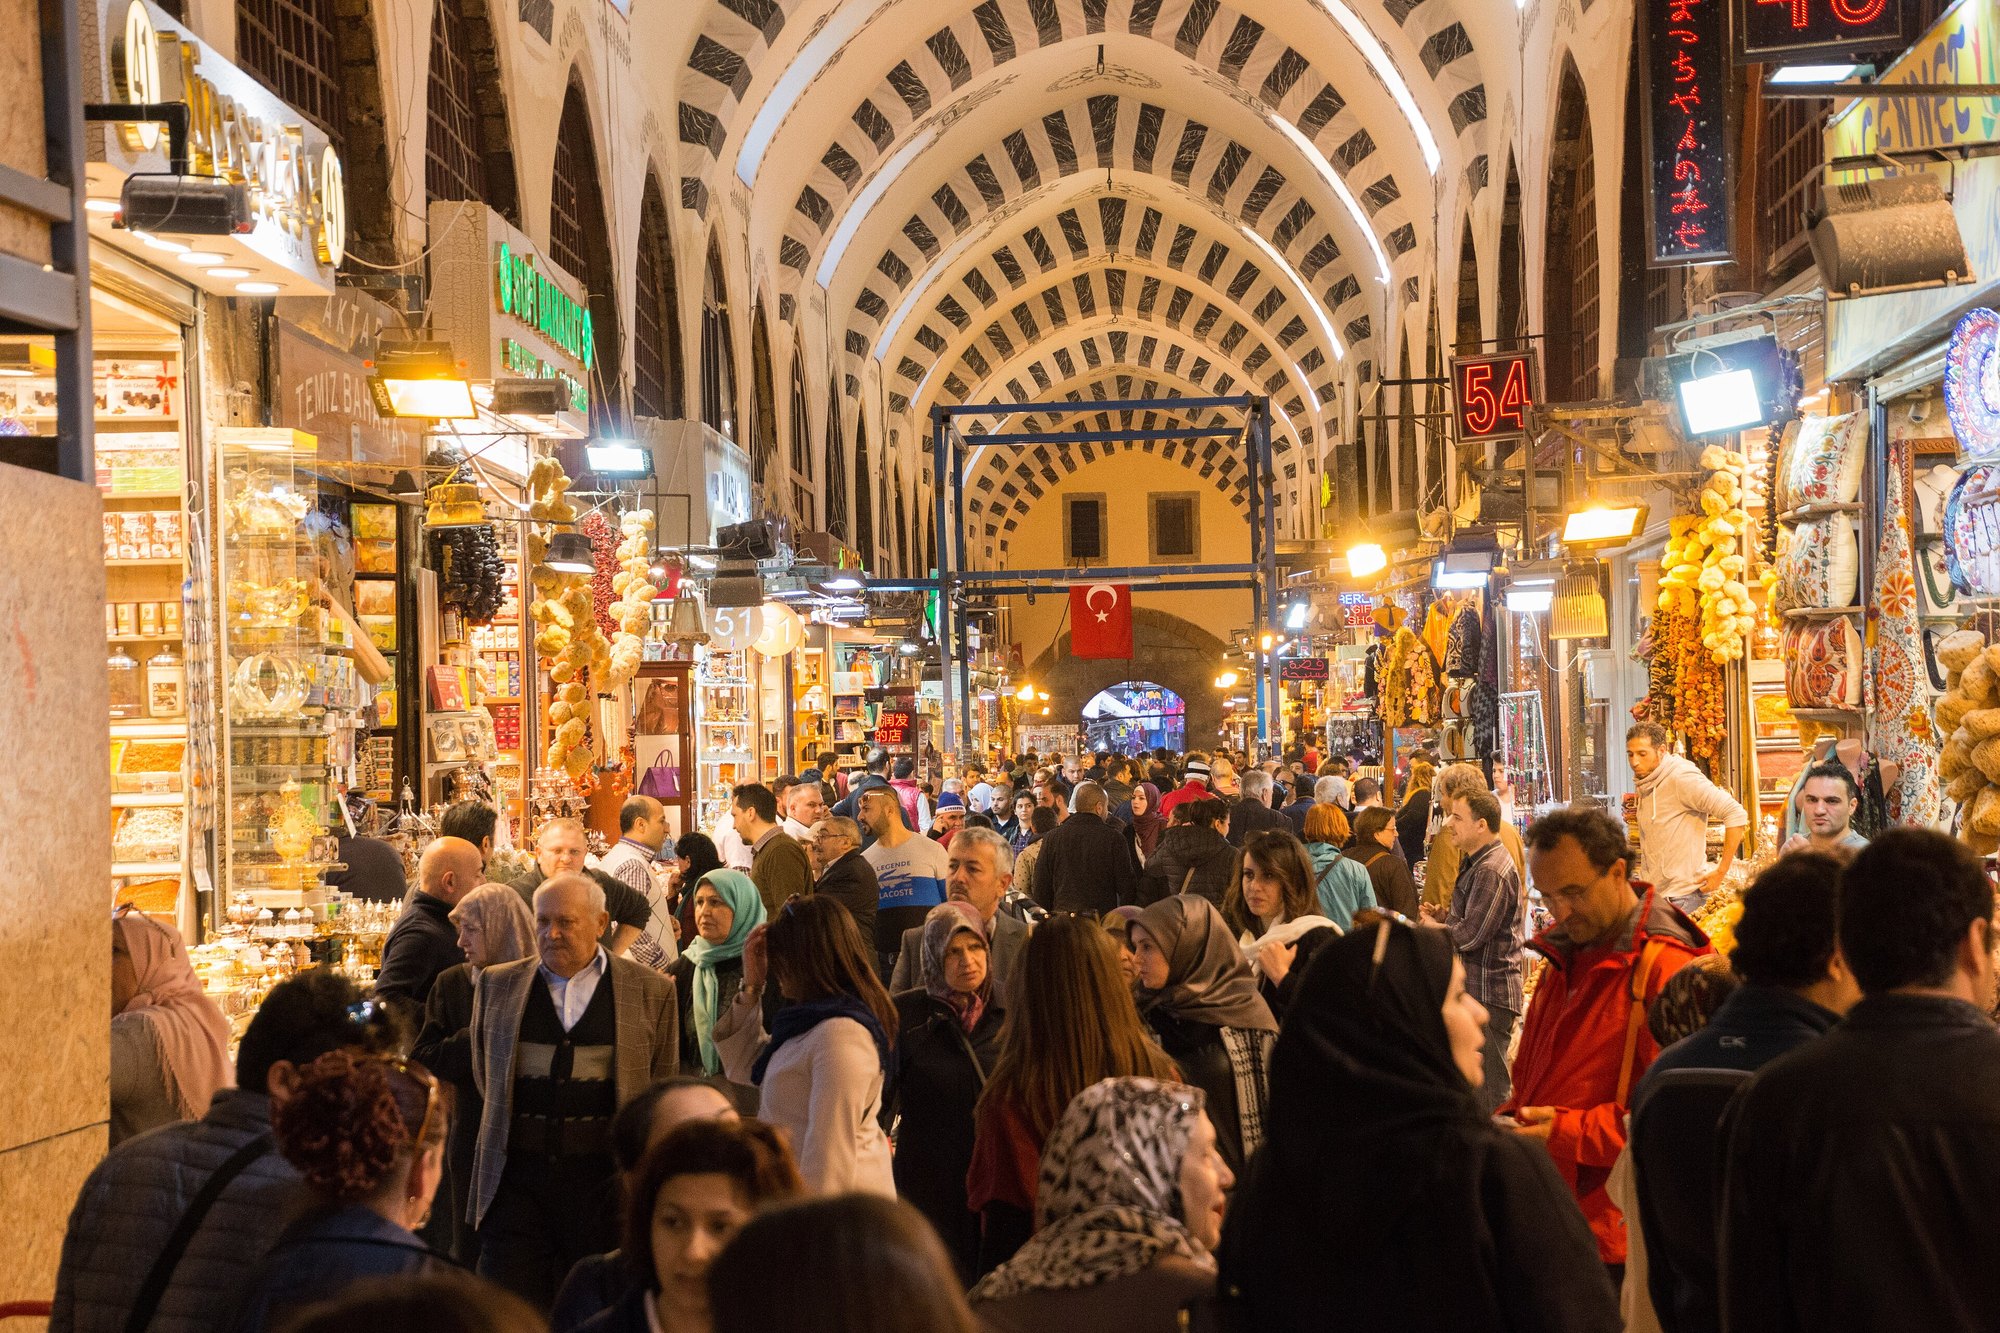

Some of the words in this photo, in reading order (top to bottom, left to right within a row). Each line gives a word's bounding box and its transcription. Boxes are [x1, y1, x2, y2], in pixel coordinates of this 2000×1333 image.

[326, 161, 340, 247] 41
[538, 274, 582, 360] BAHARAT
[1465, 360, 1532, 433] 54
[1351, 605, 1373, 614] GIF
[714, 607, 751, 637] 51
[1348, 615, 1375, 625] SHO
[874, 729, 902, 742] 的店
[876, 861, 911, 872] LEGENDE
[880, 888, 914, 899] LACOSTE
